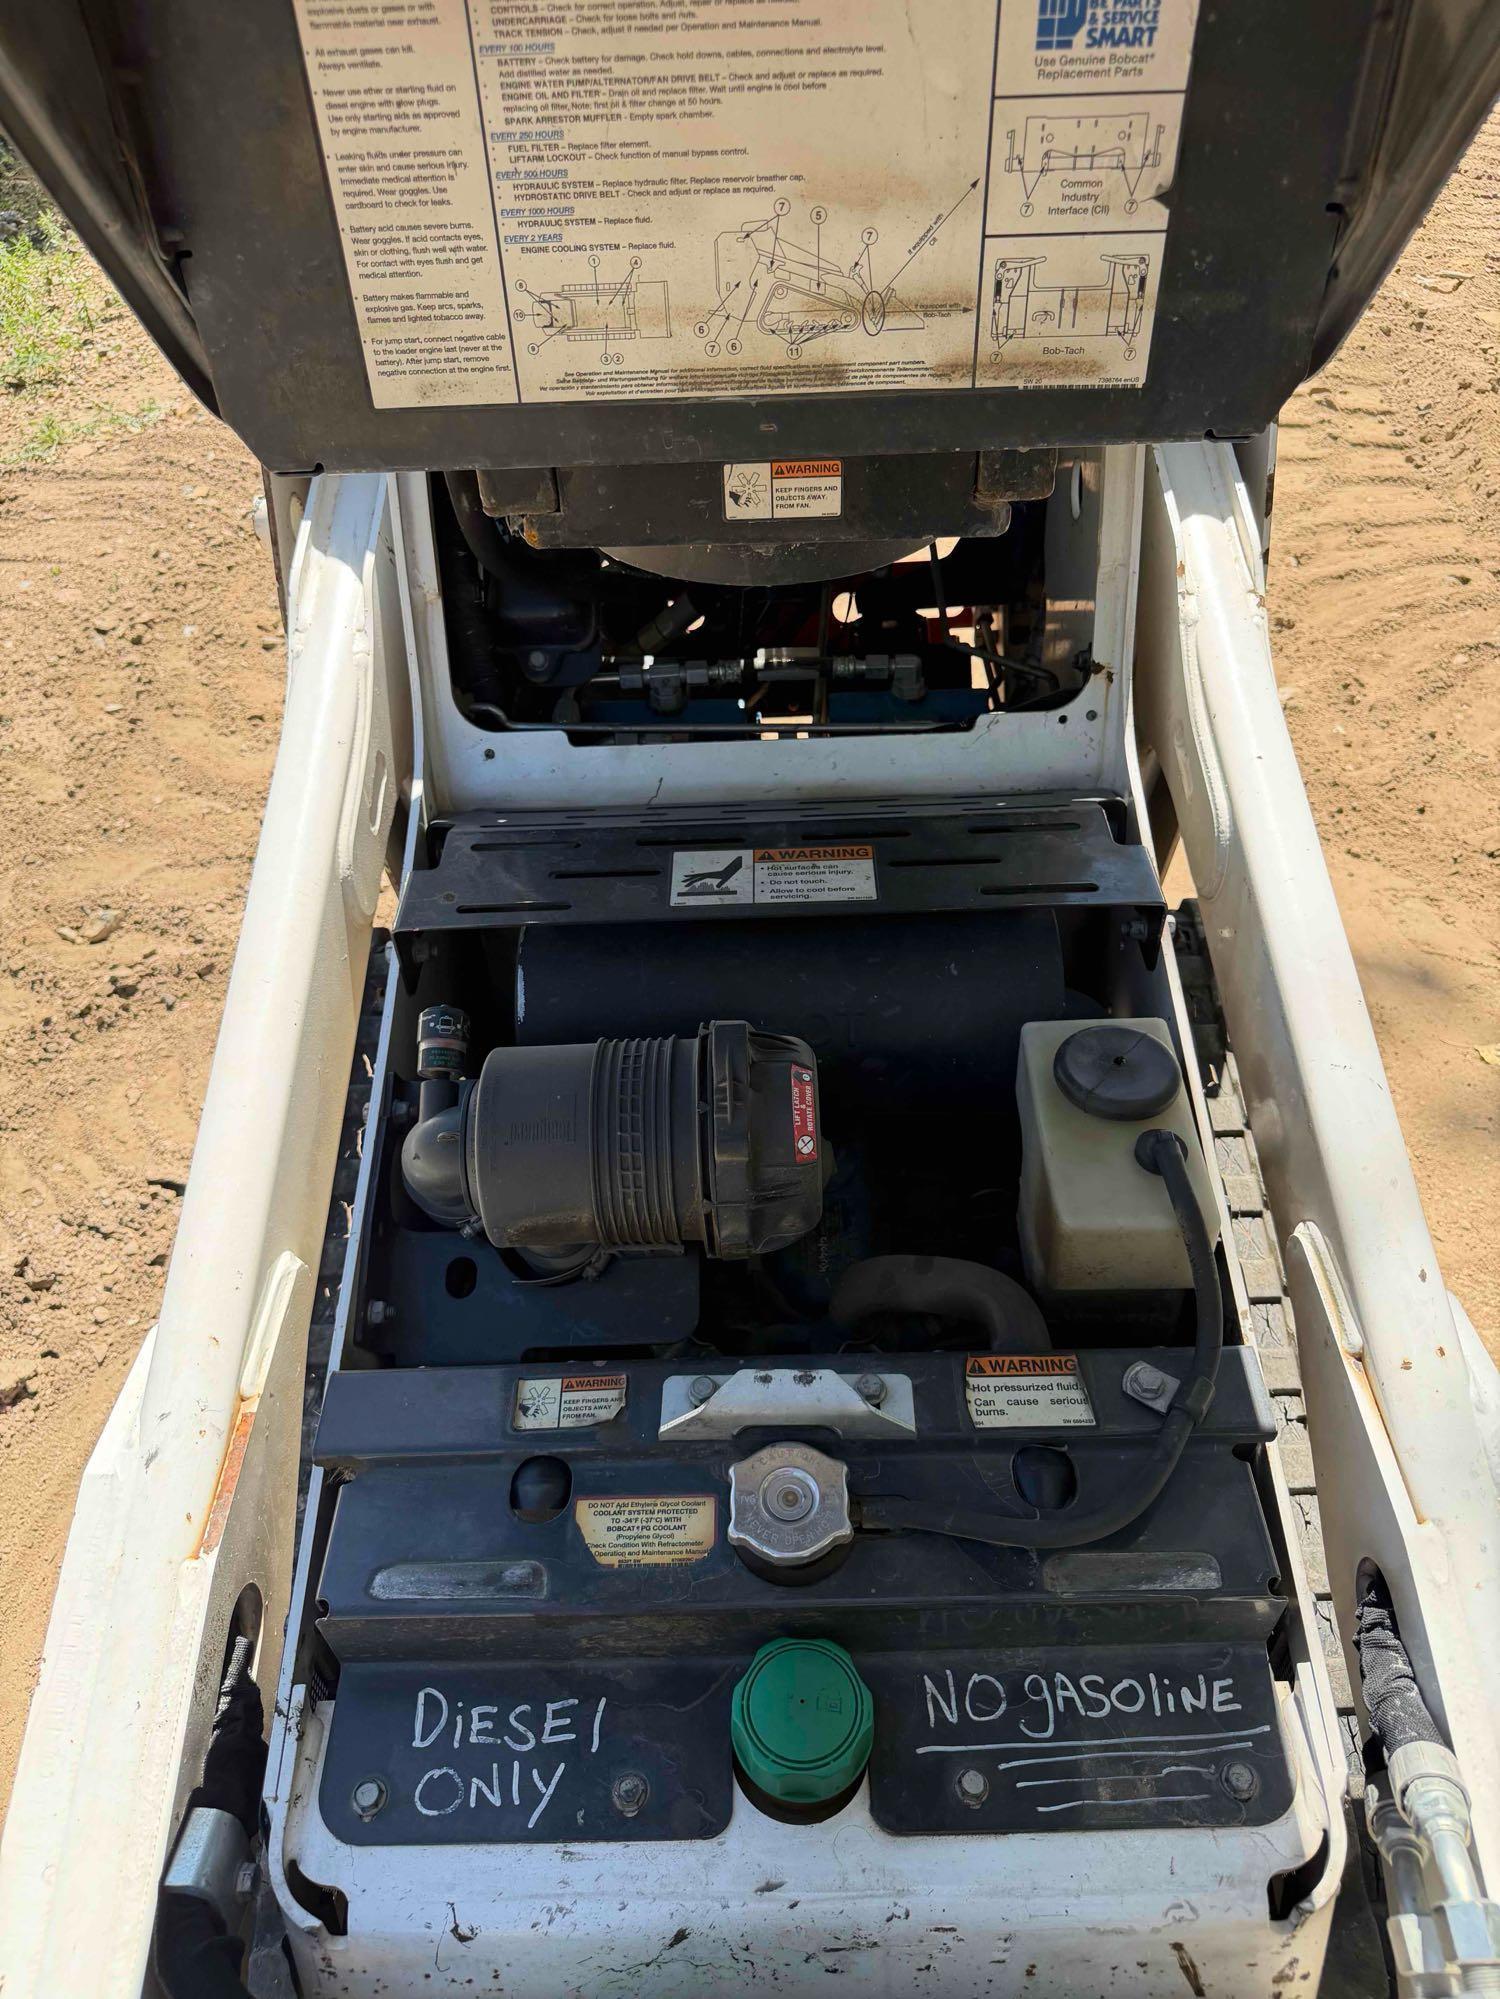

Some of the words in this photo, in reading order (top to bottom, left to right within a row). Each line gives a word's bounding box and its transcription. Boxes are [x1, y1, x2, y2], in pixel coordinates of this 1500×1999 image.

[1089, 12, 1098, 25] &
[1103, 10, 1160, 25] SERVICE
[1085, 26, 1157, 48] SMART
[1035, 57, 1056, 67] Use
[1059, 55, 1105, 66] Genuine
[1037, 68, 1111, 80] Replacement
[1114, 67, 1143, 77] Parts
[491, 132, 517, 141] EVERY
[519, 132, 534, 140] 250
[535, 130, 565, 139] HOURS
[508, 145, 529, 153] FUEL
[531, 144, 559, 152] FILTER
[568, 143, 598, 152] Replace
[496, 171, 522, 179] EVERY
[524, 170, 538, 178] 500
[539, 169, 568, 178] HOURS
[1060, 179, 1103, 189] Common
[1061, 192, 1099, 202] Industry
[501, 209, 526, 217] EVERY
[529, 208, 545, 216] 1000
[547, 207, 575, 215] HOURS
[1048, 205, 1089, 215] Interface
[518, 220, 563, 229] HYDRAULIC
[564, 218, 596, 227] SYSTEM
[604, 217, 633, 226] Replace
[635, 216, 653, 224] fluid.
[504, 235, 529, 243] EVERY
[537, 234, 563, 242] YEARS
[521, 245, 551, 254] ENGINE
[552, 244, 588, 253] COOLING
[589, 243, 620, 252] SYSTEM
[628, 242, 657, 251] Replace
[659, 241, 676, 249] fluid.
[363, 294, 389, 302] Battery
[416, 291, 454, 299] flammable
[366, 305, 399, 314] explosive
[417, 304, 436, 313] Keep
[438, 303, 455, 311] arcs,
[457, 301, 483, 310] sparks,
[790, 347, 799, 356] 11
[1043, 347, 1085, 355] Bob-Tach
[786, 464, 839, 474] WARNING
[779, 848, 870, 859] WARNING
[806, 1107, 814, 1131] ROTATE
[989, 1359, 1076, 1373] WARNING
[575, 1378, 625, 1388] WARNING
[972, 1384, 991, 1392] Hot
[994, 1383, 1054, 1393] pressurized
[974, 1398, 996, 1406] Can
[976, 1408, 1008, 1416] burns.
[616, 1533, 651, 1541] (Propylene
[652, 1532, 674, 1540] Glycol)
[923, 1669, 1007, 1728] NO
